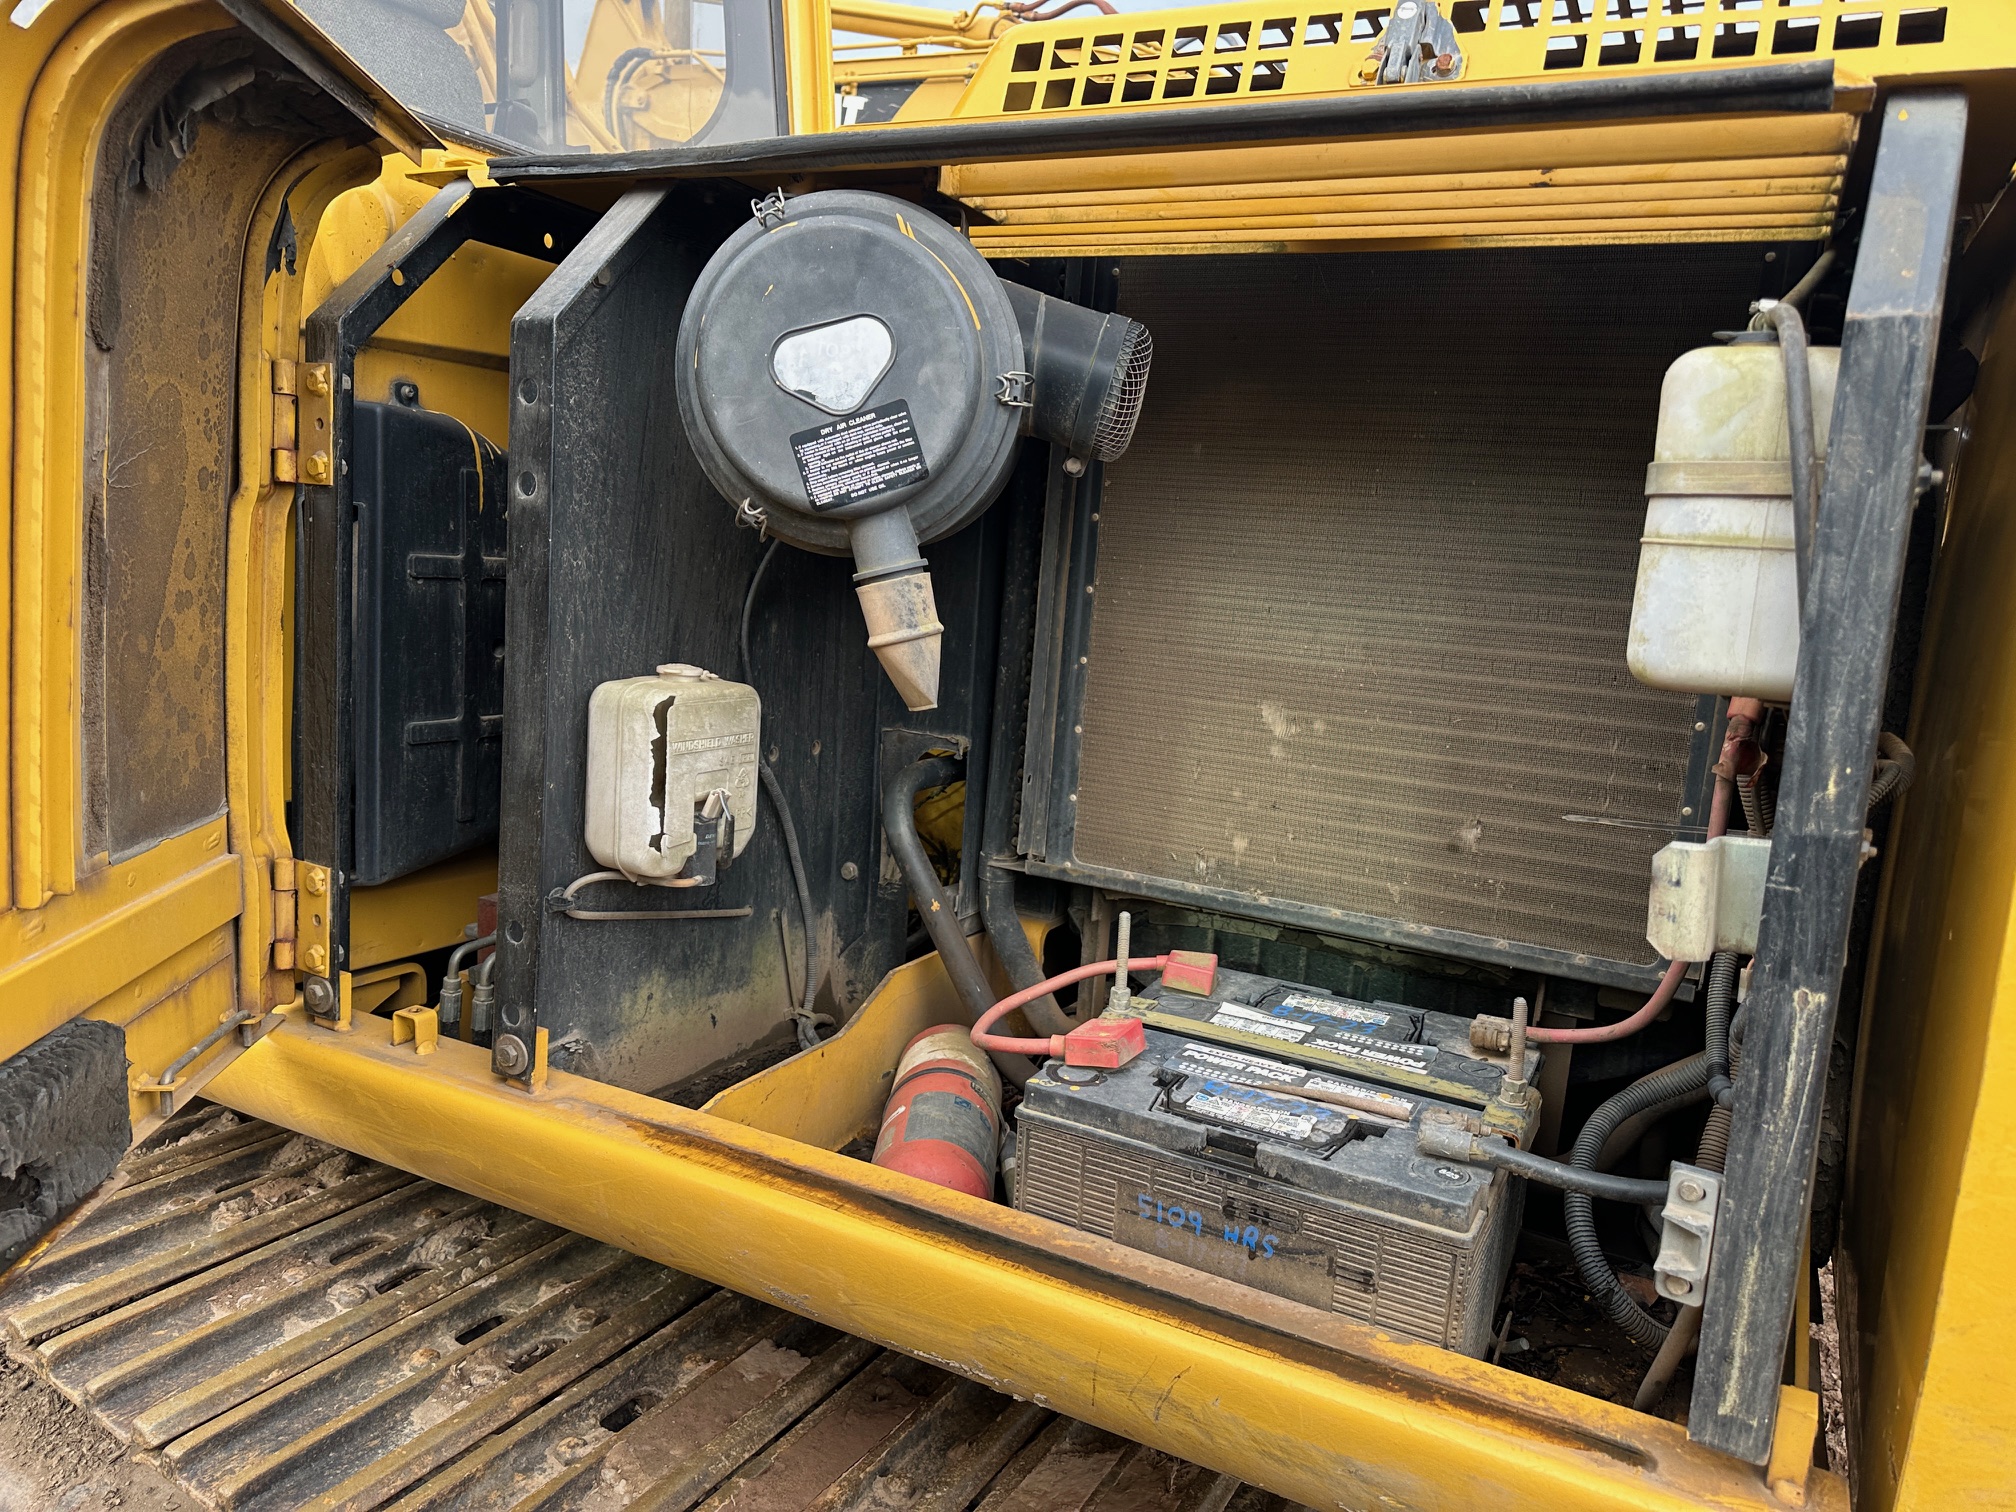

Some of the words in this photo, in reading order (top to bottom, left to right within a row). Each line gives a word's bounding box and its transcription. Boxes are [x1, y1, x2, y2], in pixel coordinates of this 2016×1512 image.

[820, 426, 833, 436] DRY
[836, 421, 848, 431] AIR
[848, 412, 877, 426] CLEANER
[672, 738, 721, 752] WINDSHIELD
[724, 733, 755, 746] WASHER
[1272, 1005, 1378, 1035] 8-17-23
[1311, 1038, 1362, 1054] PACK
[1360, 1049, 1427, 1069] POWER
[1182, 1049, 1248, 1071] POWER
[1244, 1065, 1299, 1083] PACK
[1208, 1048, 1239, 1060] EXTRA
[1241, 1057, 1272, 1068] HEAVY
[1275, 1065, 1304, 1076] DUTY
[1137, 1192, 1203, 1237] 5109
[1224, 1224, 1280, 1259] HRS
